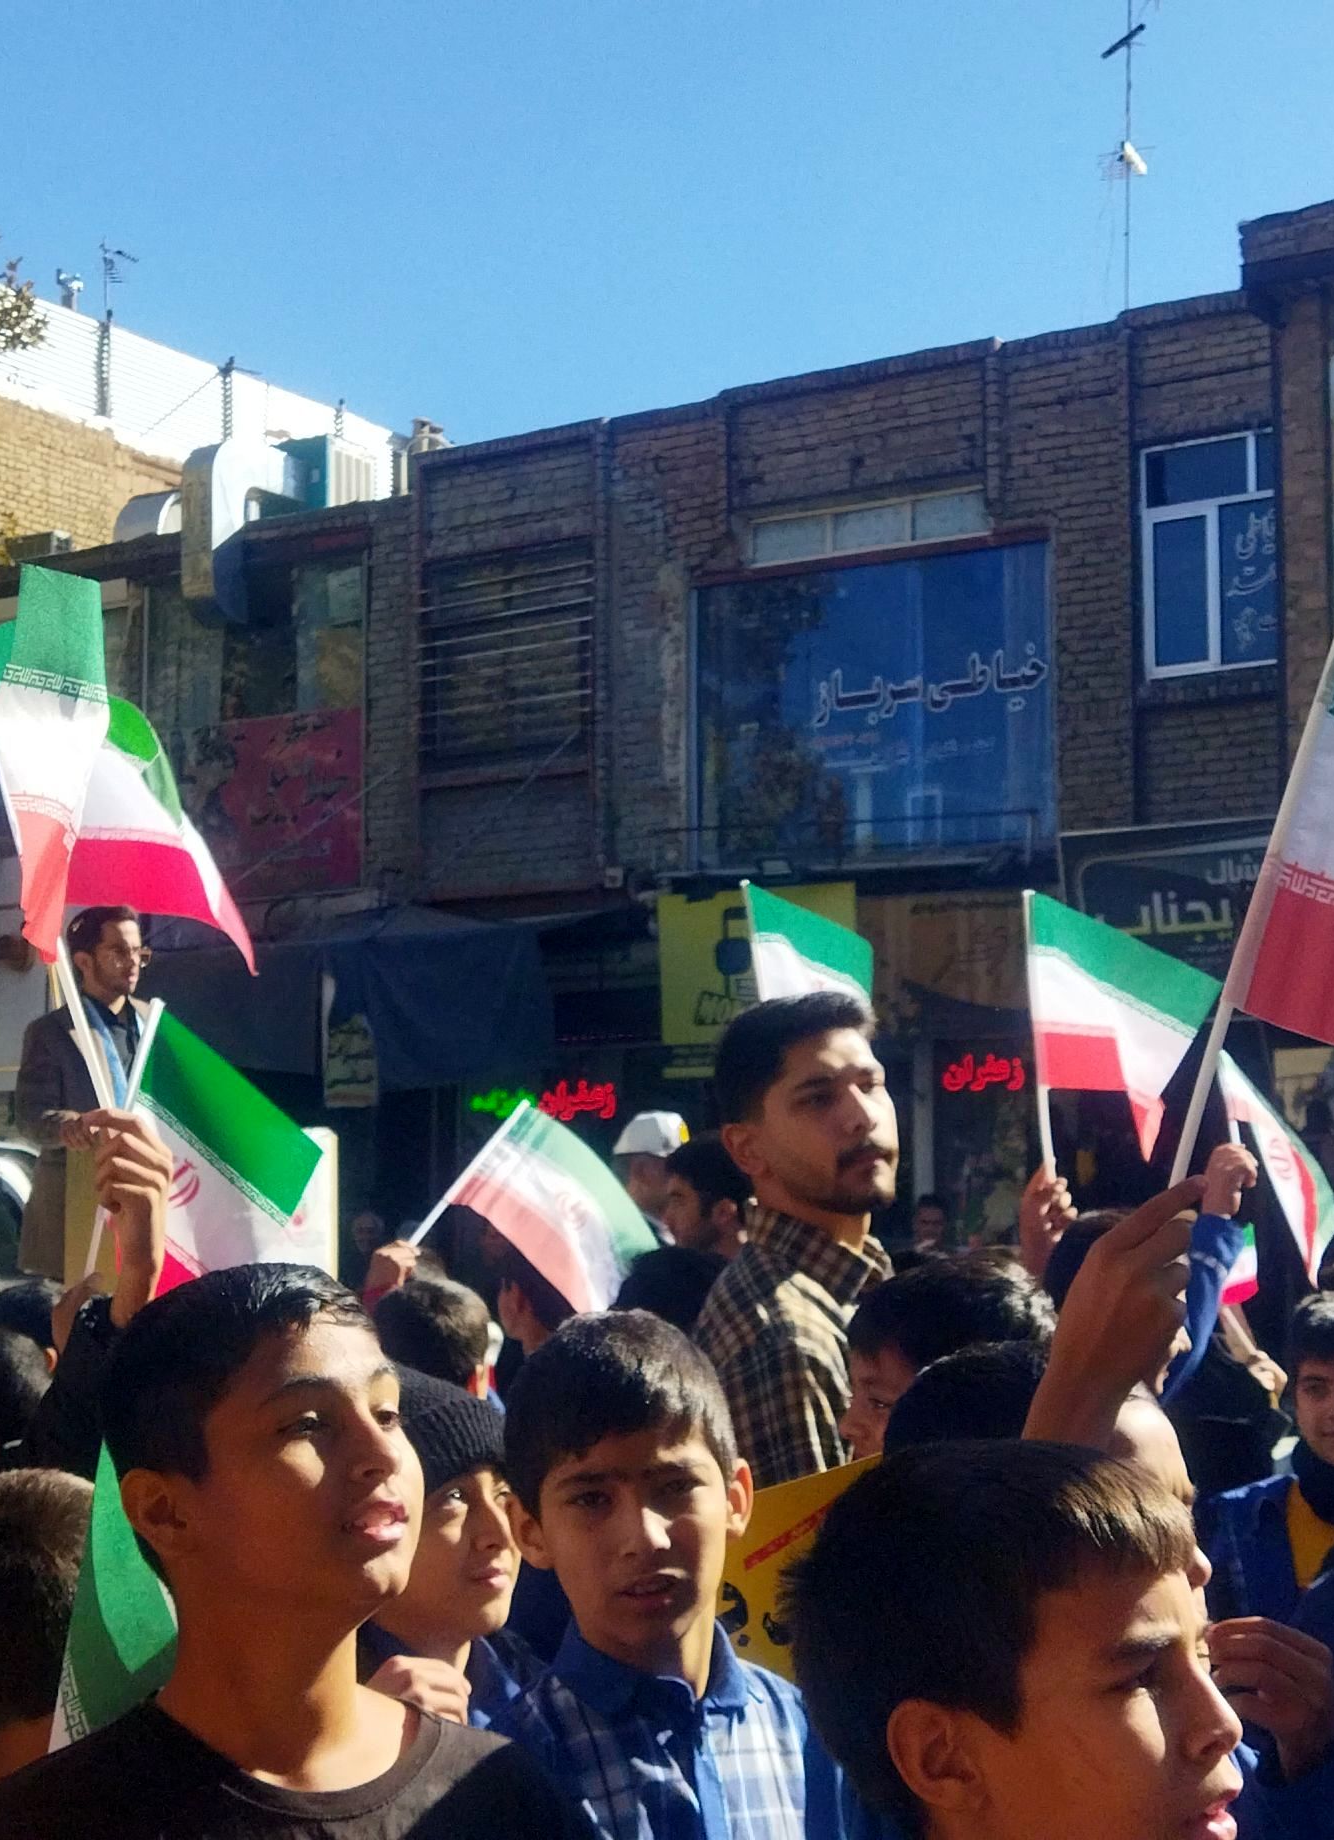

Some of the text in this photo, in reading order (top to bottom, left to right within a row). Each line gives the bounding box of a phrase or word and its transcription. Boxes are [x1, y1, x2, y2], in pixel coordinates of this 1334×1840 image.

[808, 641, 1049, 729] خیاطی سرباز
[941, 1052, 1026, 1092] زعفران
[537, 1079, 617, 1122] زعفران
